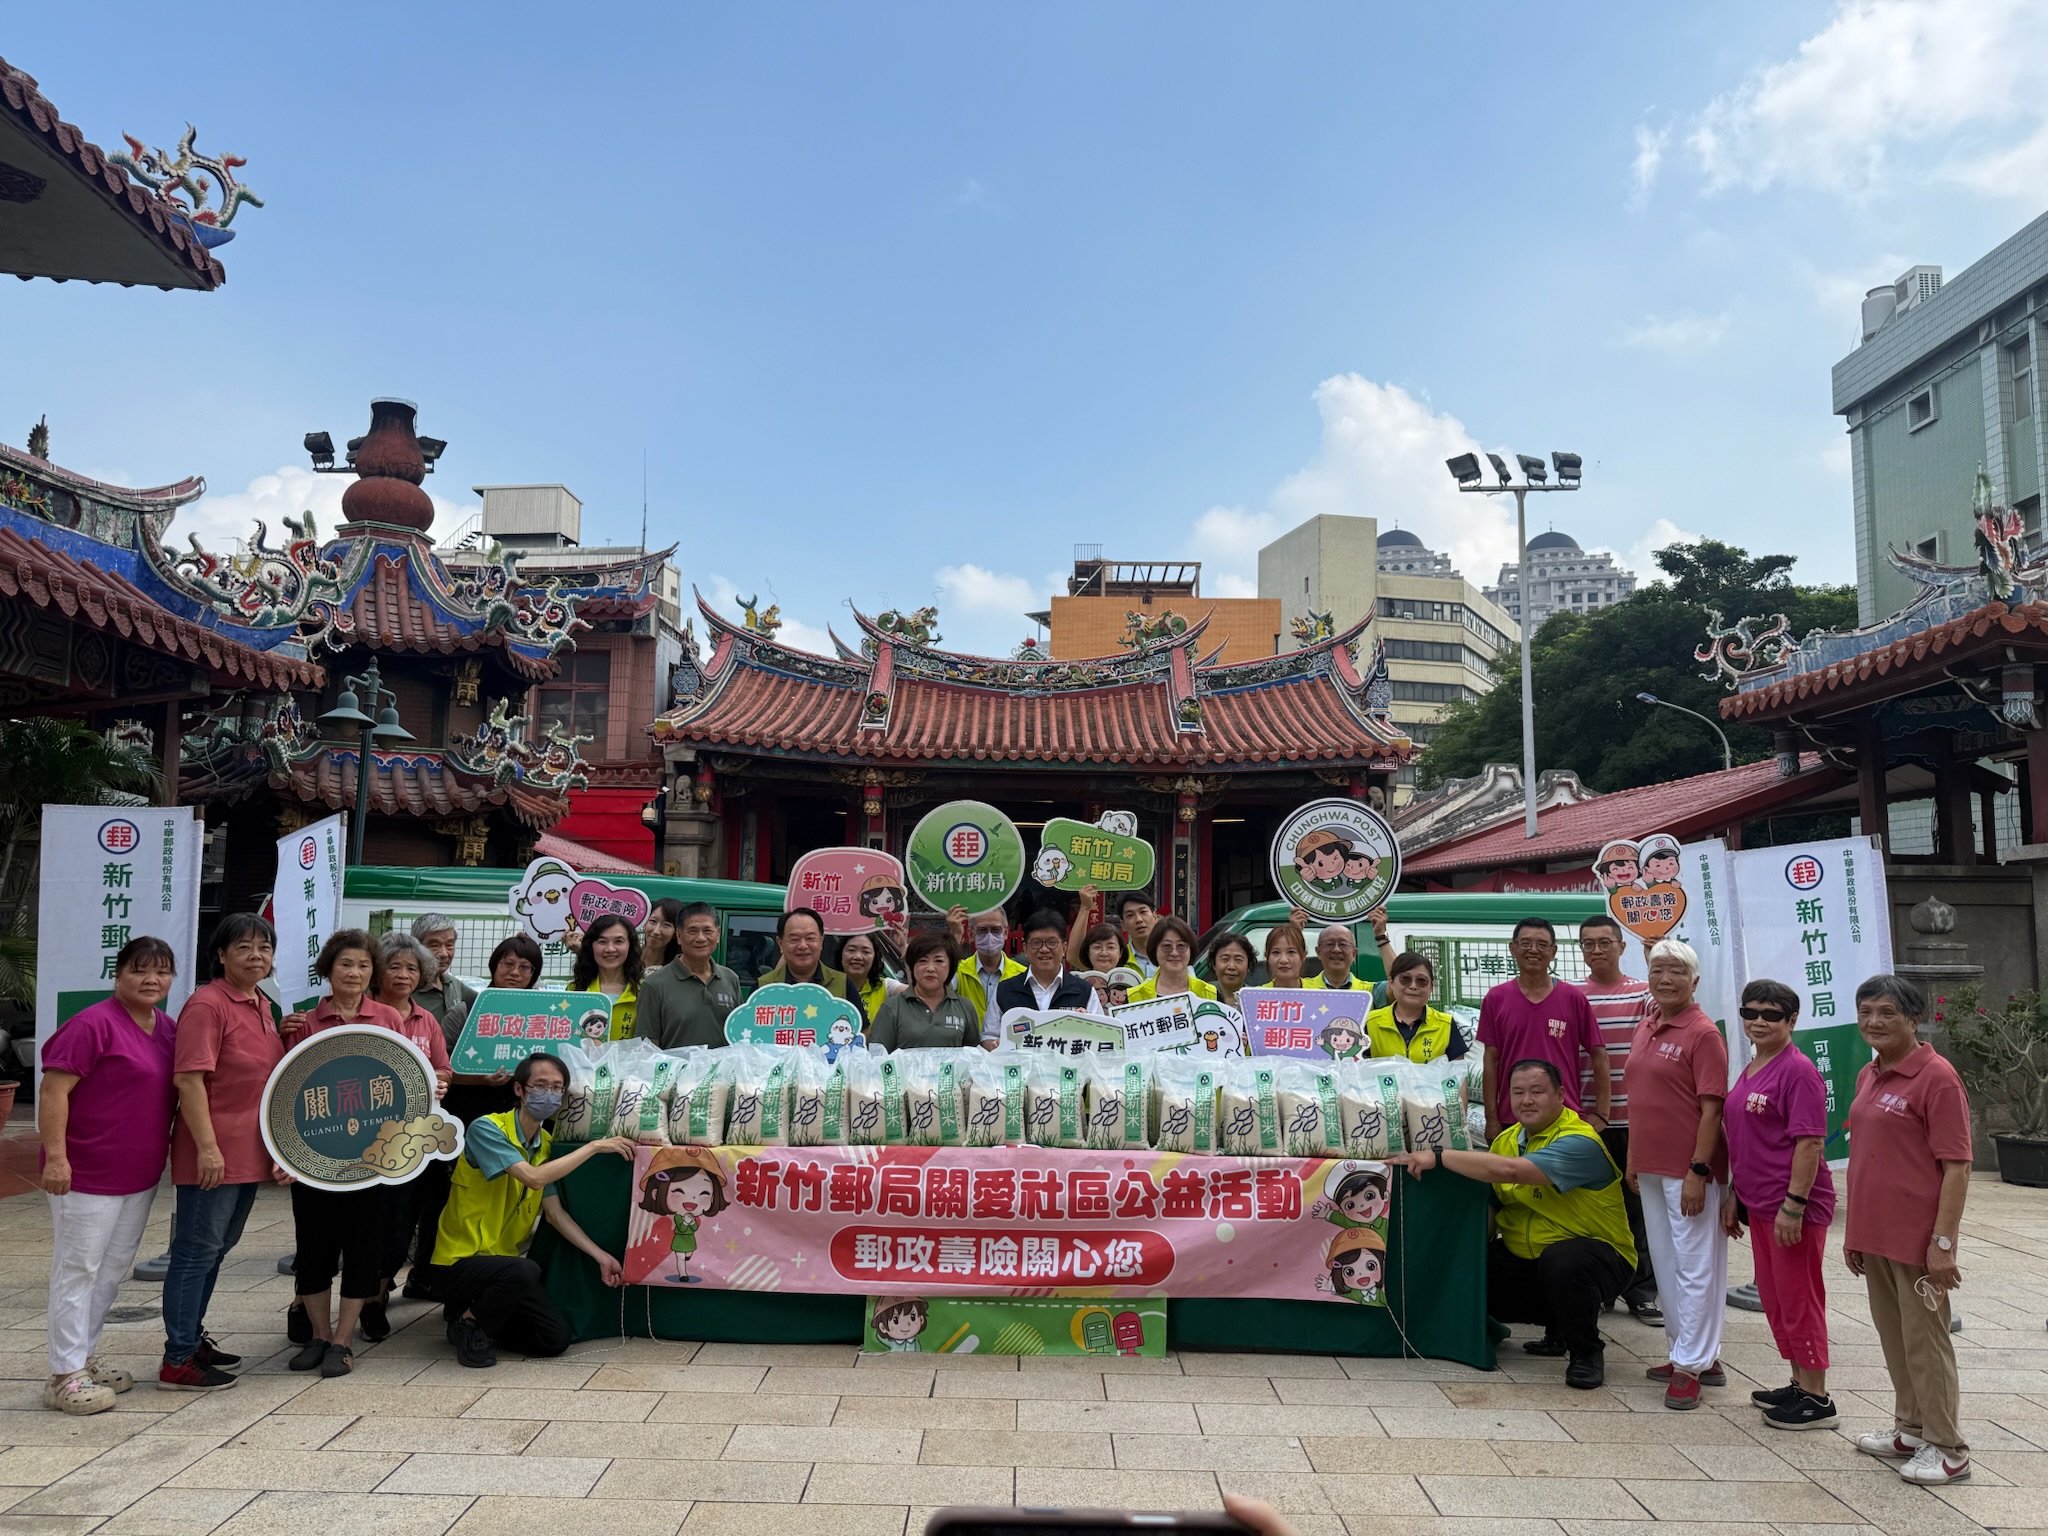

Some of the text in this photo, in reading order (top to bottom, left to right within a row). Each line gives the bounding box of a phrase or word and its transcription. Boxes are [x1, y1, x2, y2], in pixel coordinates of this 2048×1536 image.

[1286, 811, 1382, 851] CHUNGHWA POST
[1069, 834, 1114, 859] 新竹
[161, 818, 174, 912] 中華郵政股份有限公司
[326, 828, 339, 897] 中華郵政股份
[1089, 860, 1134, 883] 郵局
[802, 871, 842, 892] 新竹
[925, 871, 1006, 893] 新竹郵局
[580, 893, 638, 917] 郵政壽險
[811, 895, 852, 915] 郵局
[1621, 893, 1677, 909] 郵政壽險
[1699, 853, 1721, 946] 中華郵政股份有限公司
[1843, 848, 1861, 944] 中華郵政股份有限公司
[100, 862, 133, 980] 新竹郵局
[1626, 908, 1673, 924] 關心您
[303, 875, 322, 988] 新竹郵局
[1795, 897, 1836, 1018] 新竹郵局
[755, 1005, 797, 1026] 新竹
[1256, 1000, 1304, 1022] 新竹
[476, 1013, 573, 1040] 郵政壽險
[619, 1012, 632, 1040] 新竹
[774, 1028, 816, 1047] 郵局
[1125, 1013, 1190, 1040] 新竹郵局
[1264, 1027, 1313, 1050] 郵局
[1422, 1037, 1433, 1064] 新竹
[1813, 1040, 1832, 1073] 可靠
[304, 1074, 394, 1121] 關帝廟
[303, 1124, 344, 1137] GUANDI
[735, 1159, 1303, 1222] 新竹郵局關愛社區公益活動
[853, 1233, 1143, 1279] 郵政壽險關心您
